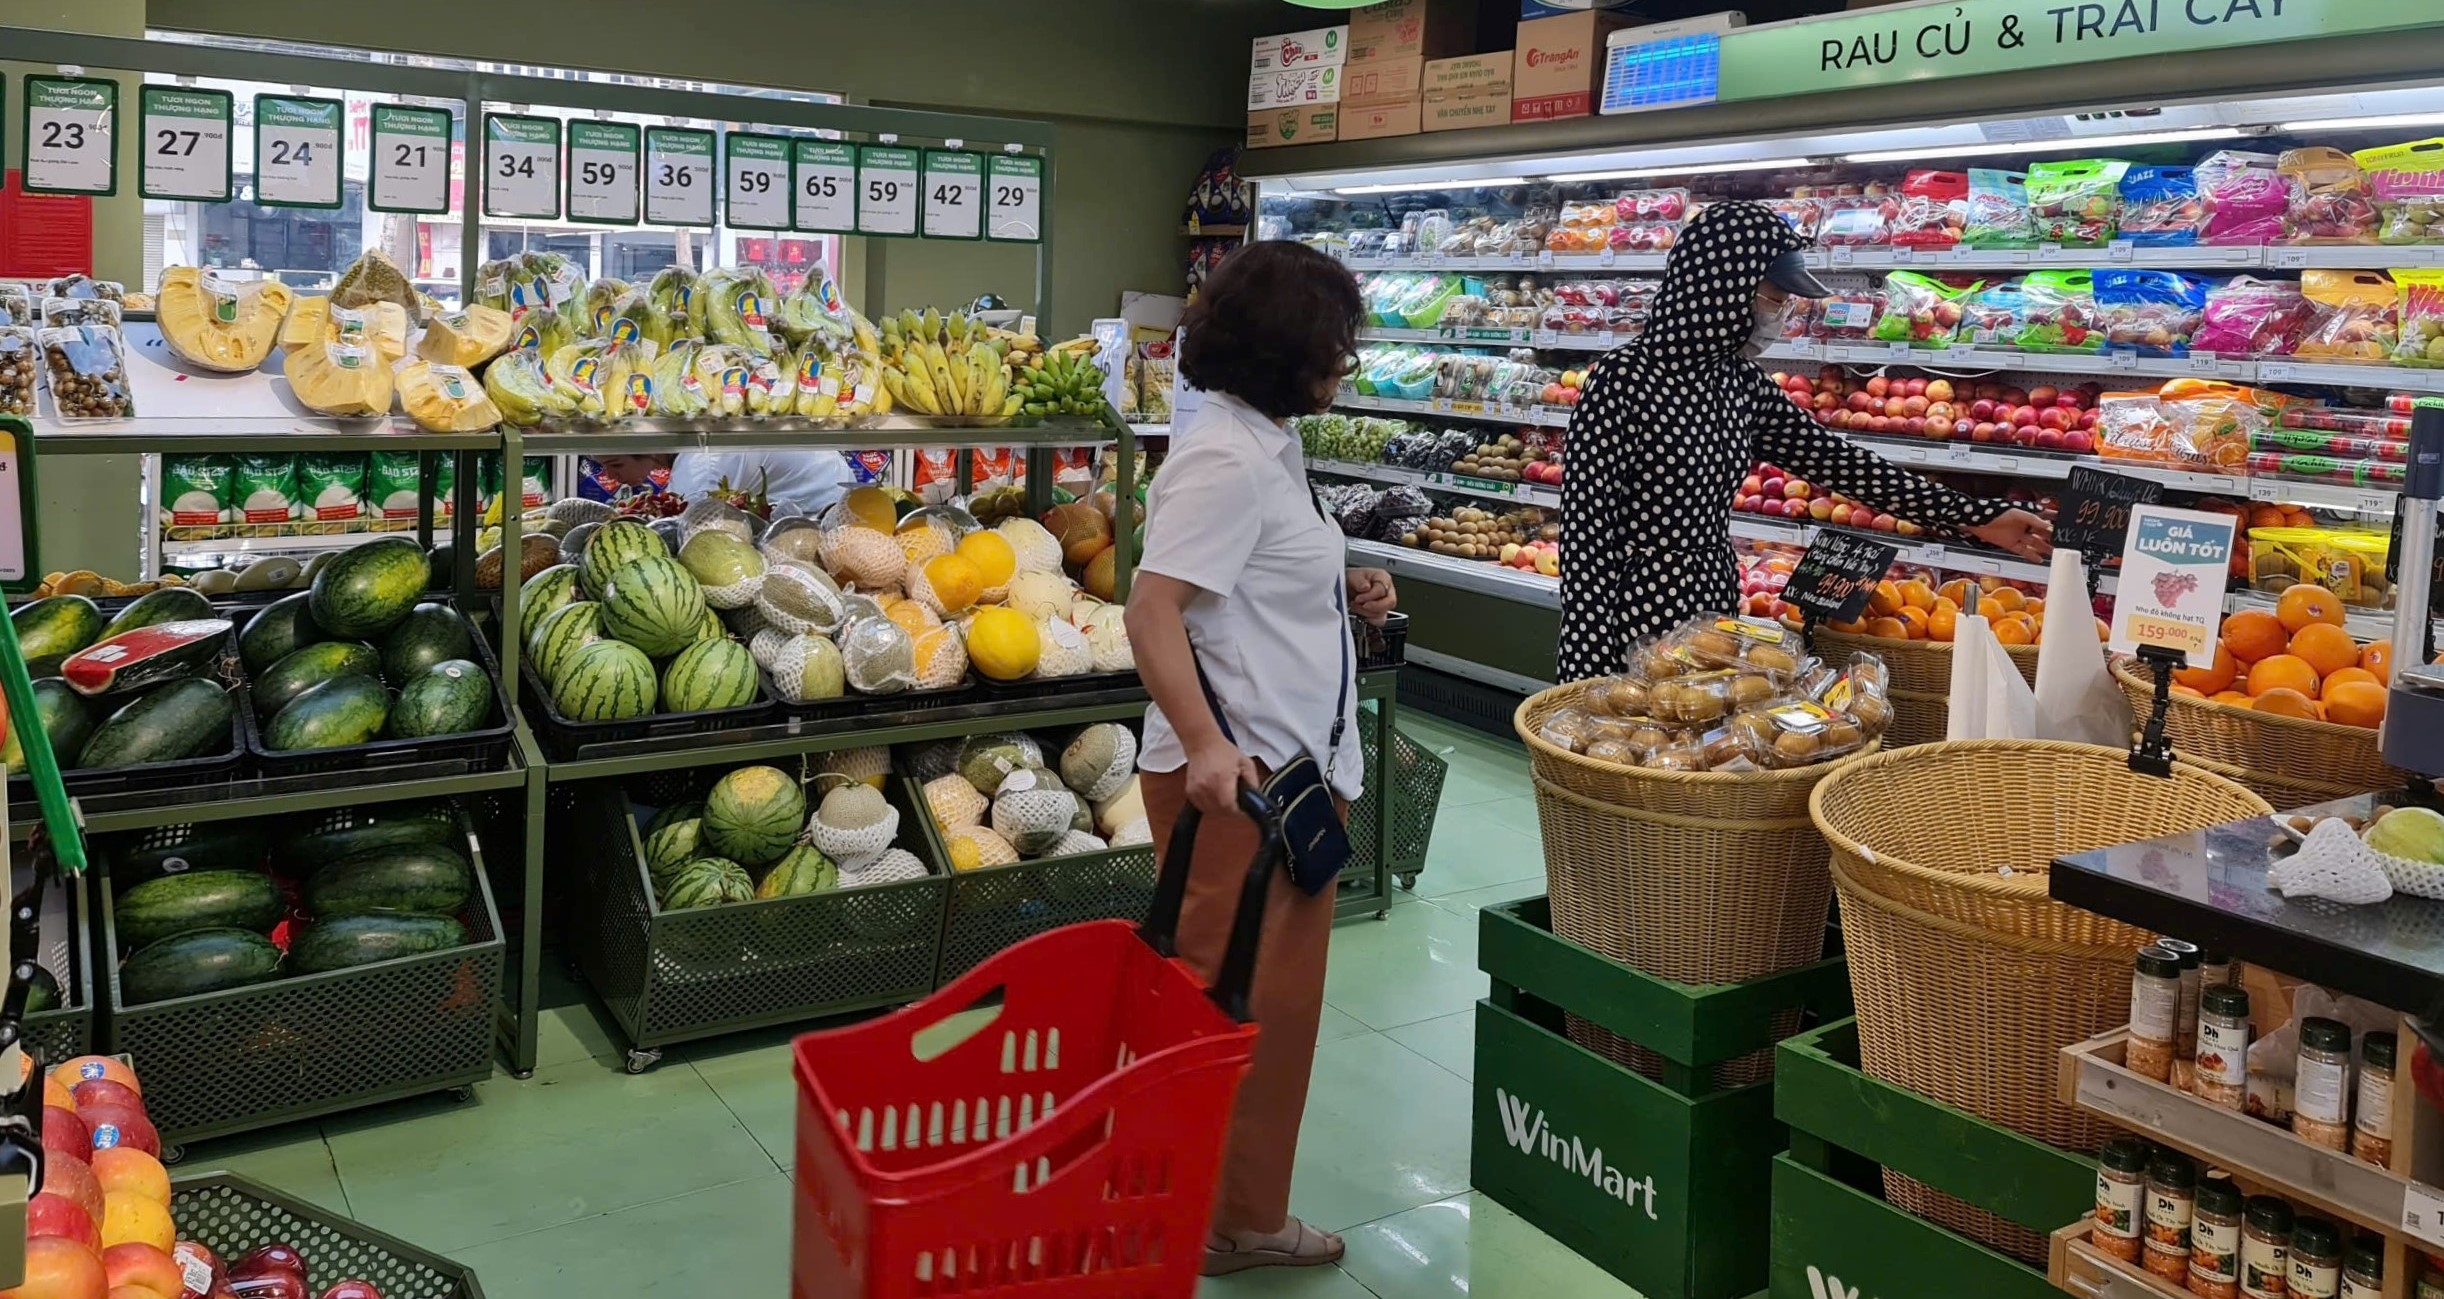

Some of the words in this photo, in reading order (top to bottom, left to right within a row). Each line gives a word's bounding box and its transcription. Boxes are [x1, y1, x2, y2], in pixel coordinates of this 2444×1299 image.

[1821, 30, 1897, 71] RAU
[1916, 8, 1970, 58] CỦ
[1998, 15, 2024, 49] &
[184, 97, 211, 105] NGON
[298, 107, 324, 115] NGON
[1486, 105, 1496, 114] TAY
[42, 121, 84, 149] 23
[157, 129, 201, 156] 27
[271, 140, 312, 166] 24
[395, 144, 426, 167] 21
[499, 154, 535, 179] 34
[582, 162, 615, 186] 59
[658, 164, 692, 188] 36
[2128, 169, 2154, 185] JAZZ
[740, 171, 770, 193] 59
[806, 175, 836, 197] 65
[869, 181, 897, 202] 59
[933, 185, 962, 205] 42
[997, 186, 1024, 207] 29
[2106, 276, 2127, 288] JAZZ
[2168, 525, 2193, 539] GIÁ
[2139, 536, 2186, 554] LUÔN
[2189, 540, 2224, 558] TỐT
[2150, 607, 2159, 616] đỏ
[2160, 610, 2181, 620] không
[2183, 614, 2193, 622] hạt
[2196, 616, 2204, 624] TQ
[2204, 1025, 2219, 1038] Dh
[1497, 1087, 1658, 1221] WinMart
[2159, 1198, 2175, 1212] Dh
[2199, 1222, 2214, 1237] Dh
[2296, 1263, 2312, 1278] Dh
